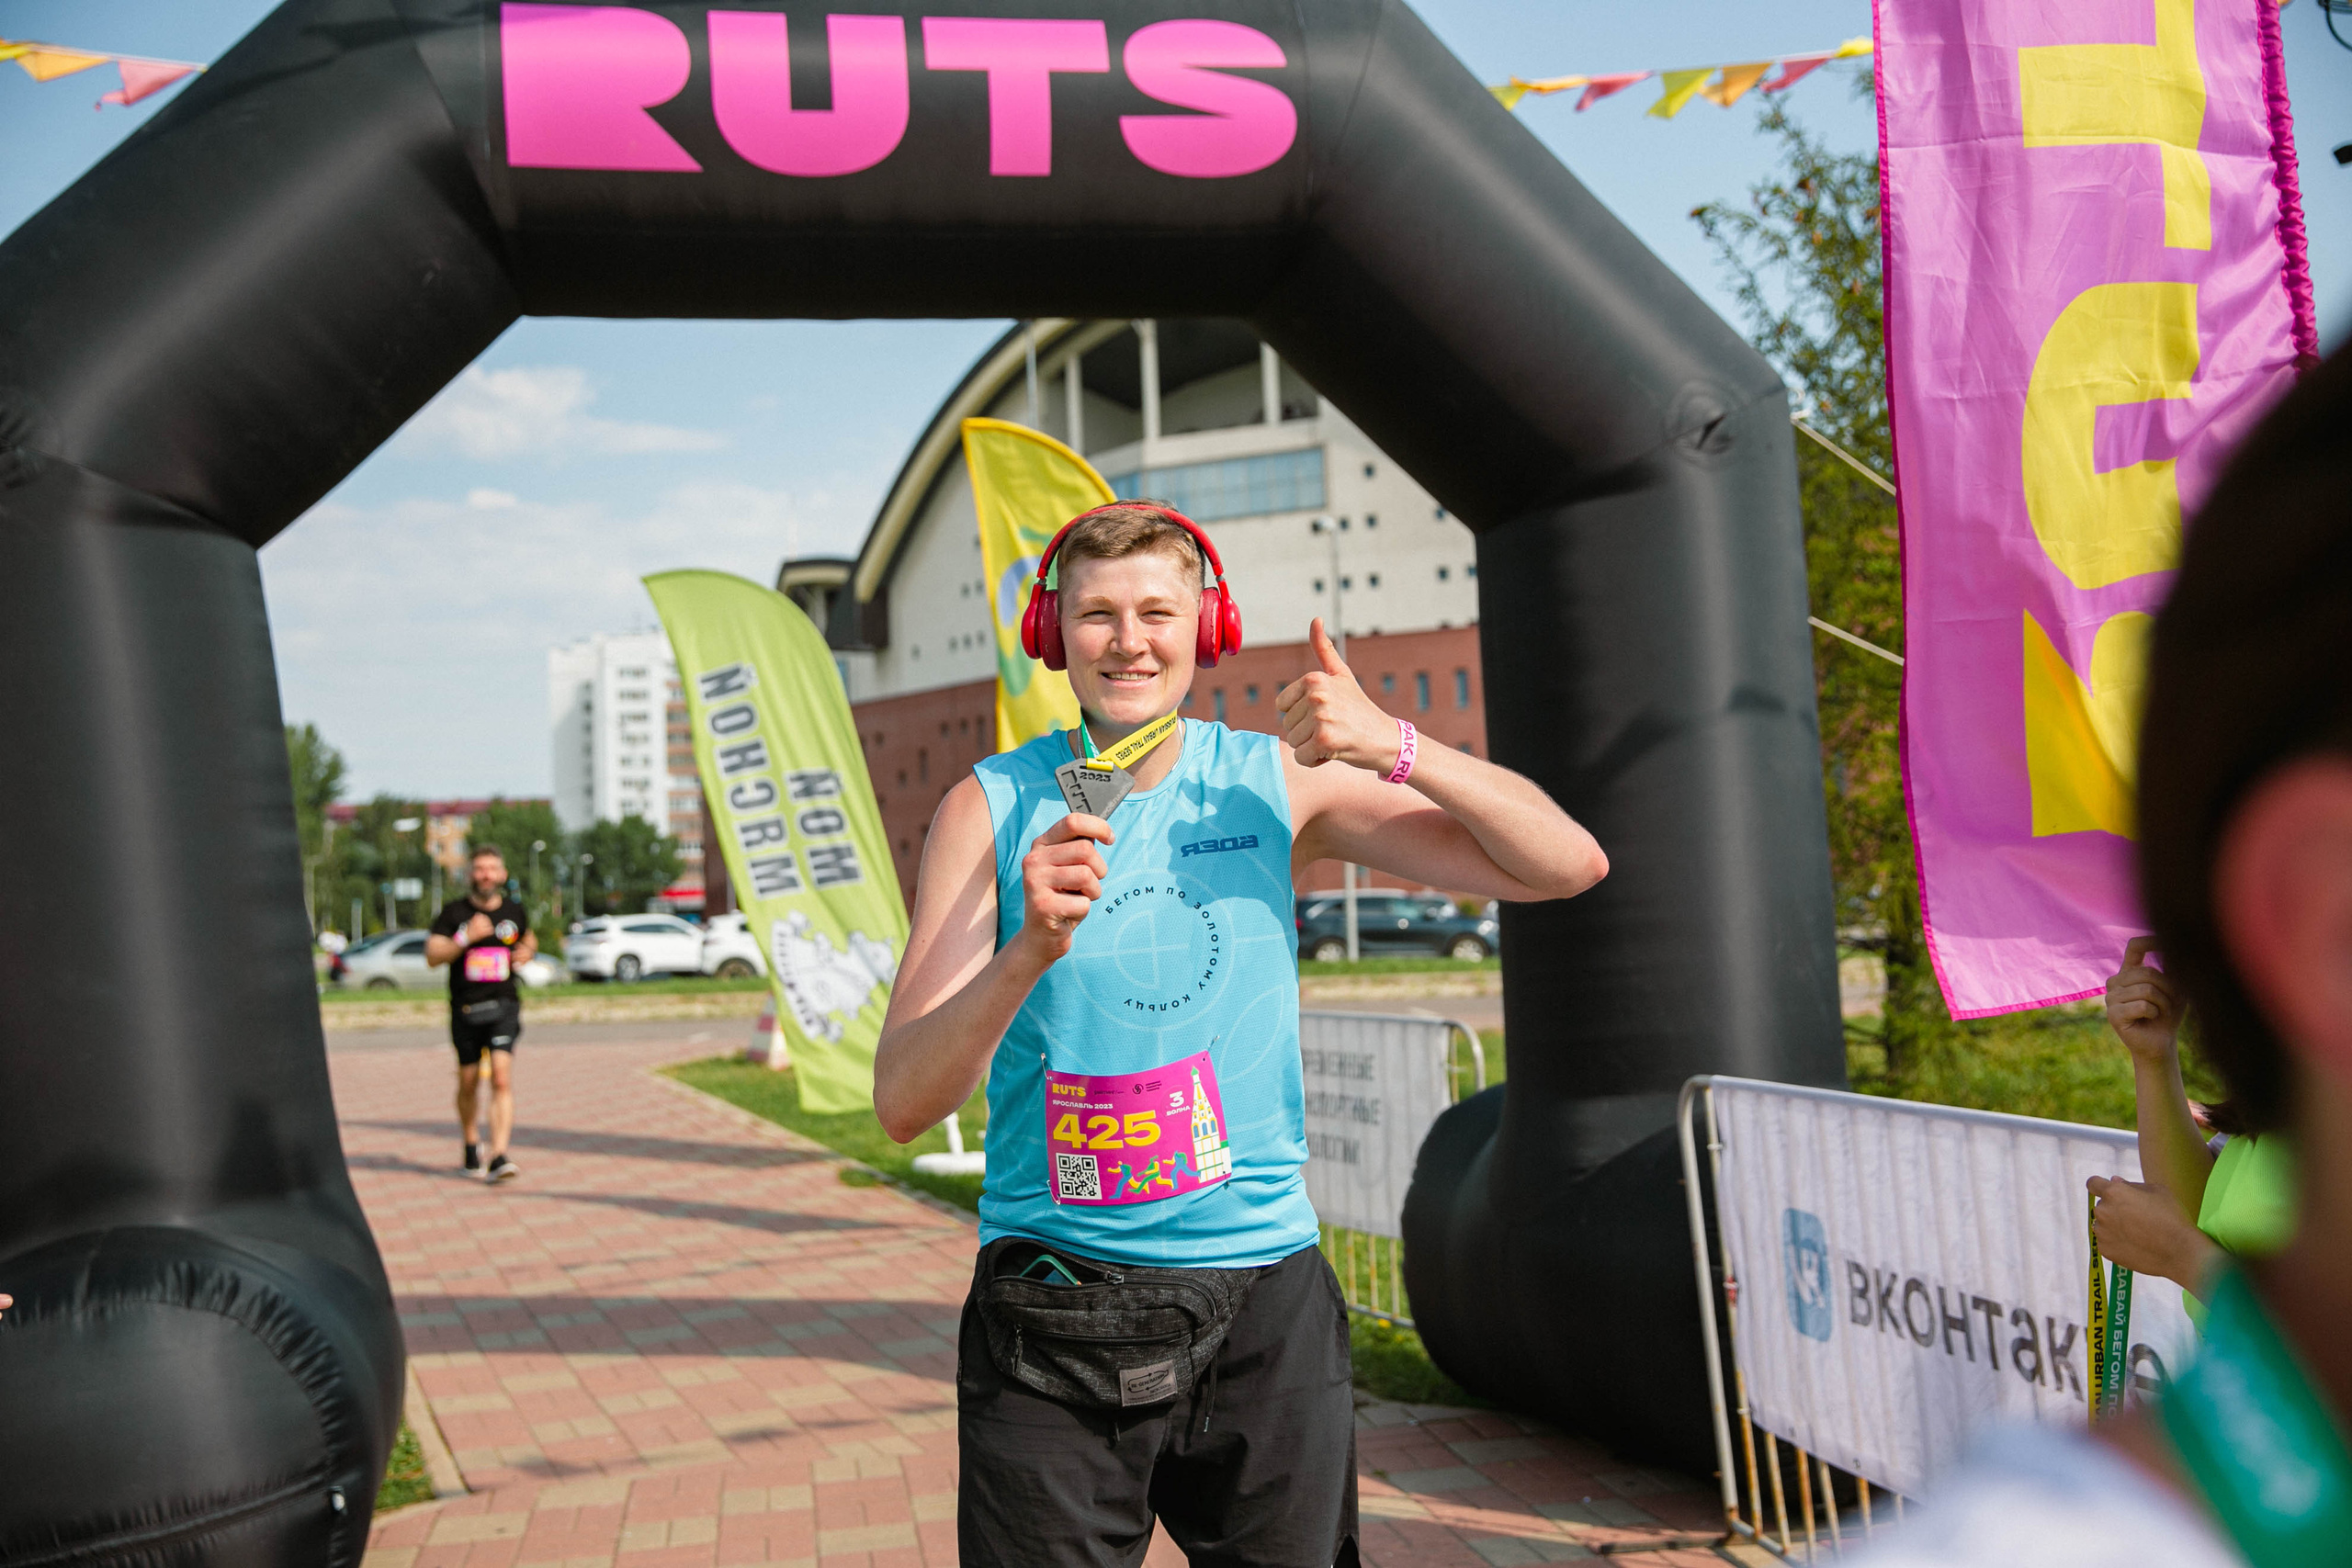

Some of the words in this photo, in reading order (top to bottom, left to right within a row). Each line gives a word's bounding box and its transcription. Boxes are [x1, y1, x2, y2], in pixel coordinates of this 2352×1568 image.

[500, 2, 1298, 178] RUTS
[1115, 745, 1133, 761] SERIES
[1079, 771, 1112, 783] 2023
[1105, 886, 1154, 914] БЕГОМ
[1166, 887, 1186, 899] ПО
[1193, 901, 1219, 990] ЗОЛОТОМУ
[1124, 994, 1191, 1011] КОЛЬЦУ
[1052, 1083, 1087, 1098] RUTS
[1169, 1090, 1185, 1108] 3
[1052, 1100, 1093, 1110] ЯРОСЛАВЛЬ
[1166, 1105, 1191, 1116] ВОЛНА
[1053, 1110, 1161, 1149] 425
[2093, 1272, 2103, 1323] TRAIL
[2115, 1265, 2128, 1325] ДАВАЙ
[2094, 1326, 2103, 1388] URBAN
[2109, 1330, 2122, 1389] БЕГОМ
